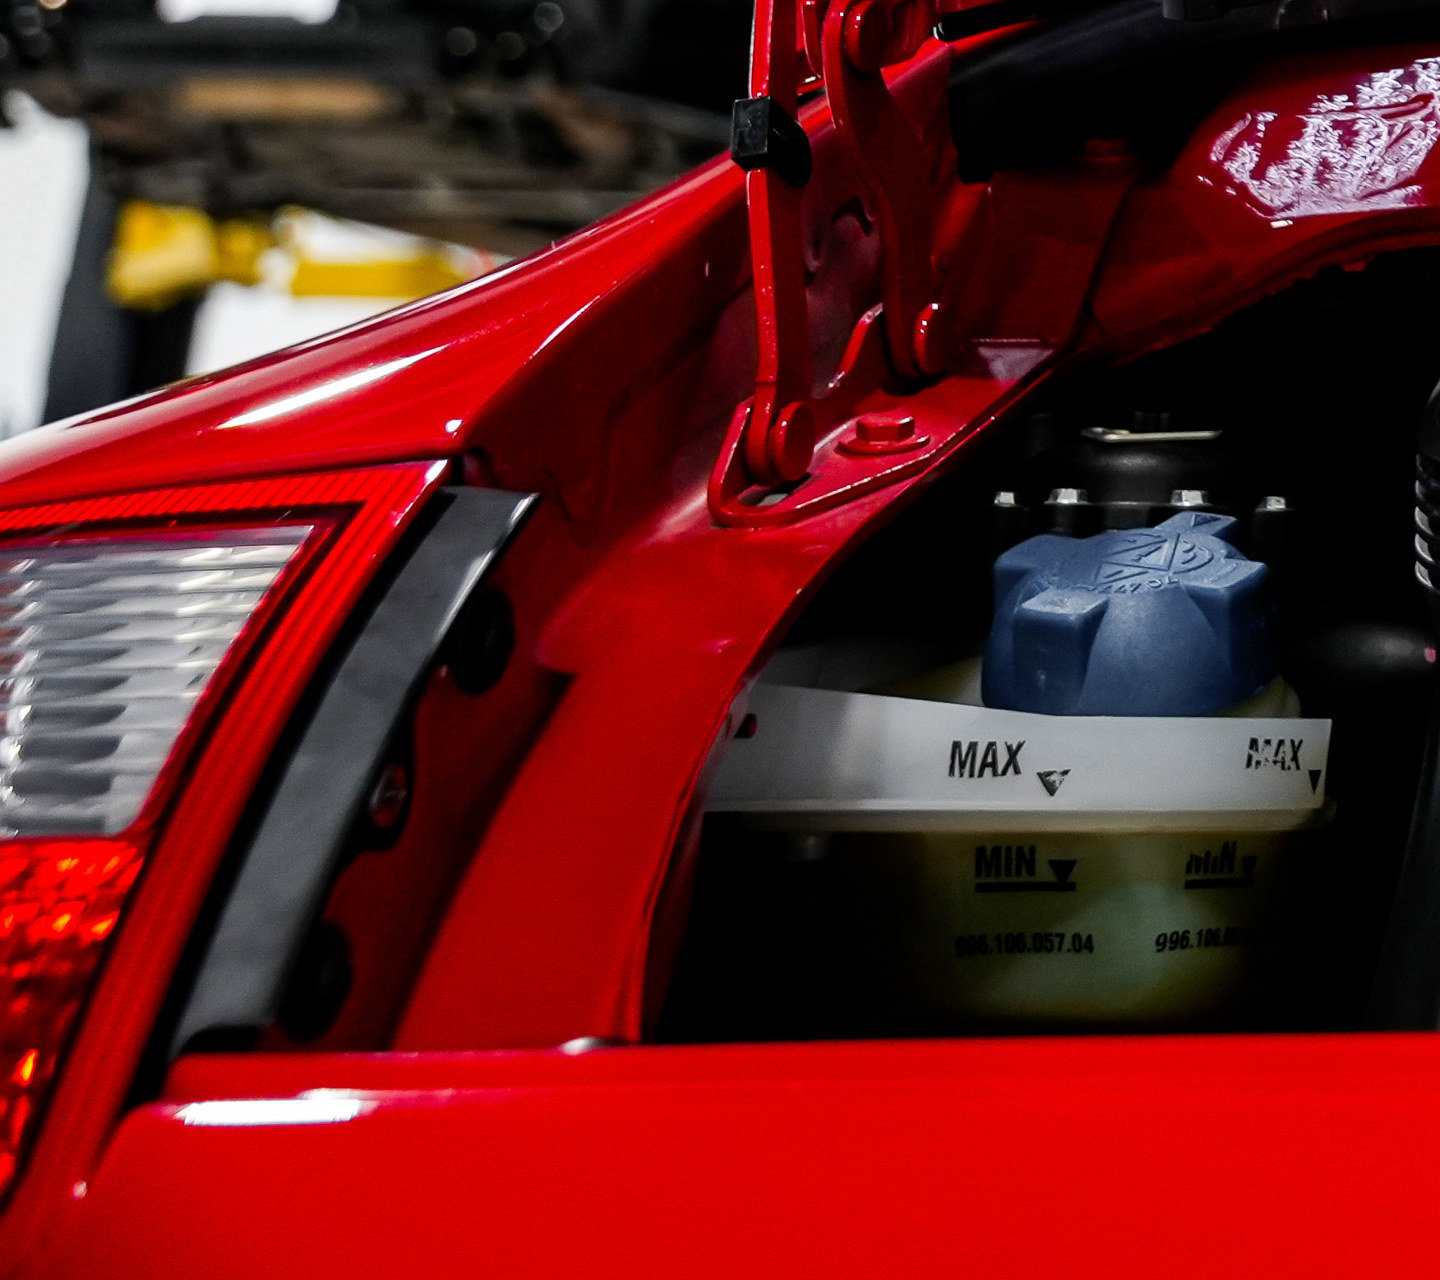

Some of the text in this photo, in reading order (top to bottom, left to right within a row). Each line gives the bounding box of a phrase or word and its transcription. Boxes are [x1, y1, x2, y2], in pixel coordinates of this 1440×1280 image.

[948, 740, 1026, 778] MAX
[1246, 737, 1303, 771] MAX
[975, 845, 1037, 878] MIN
